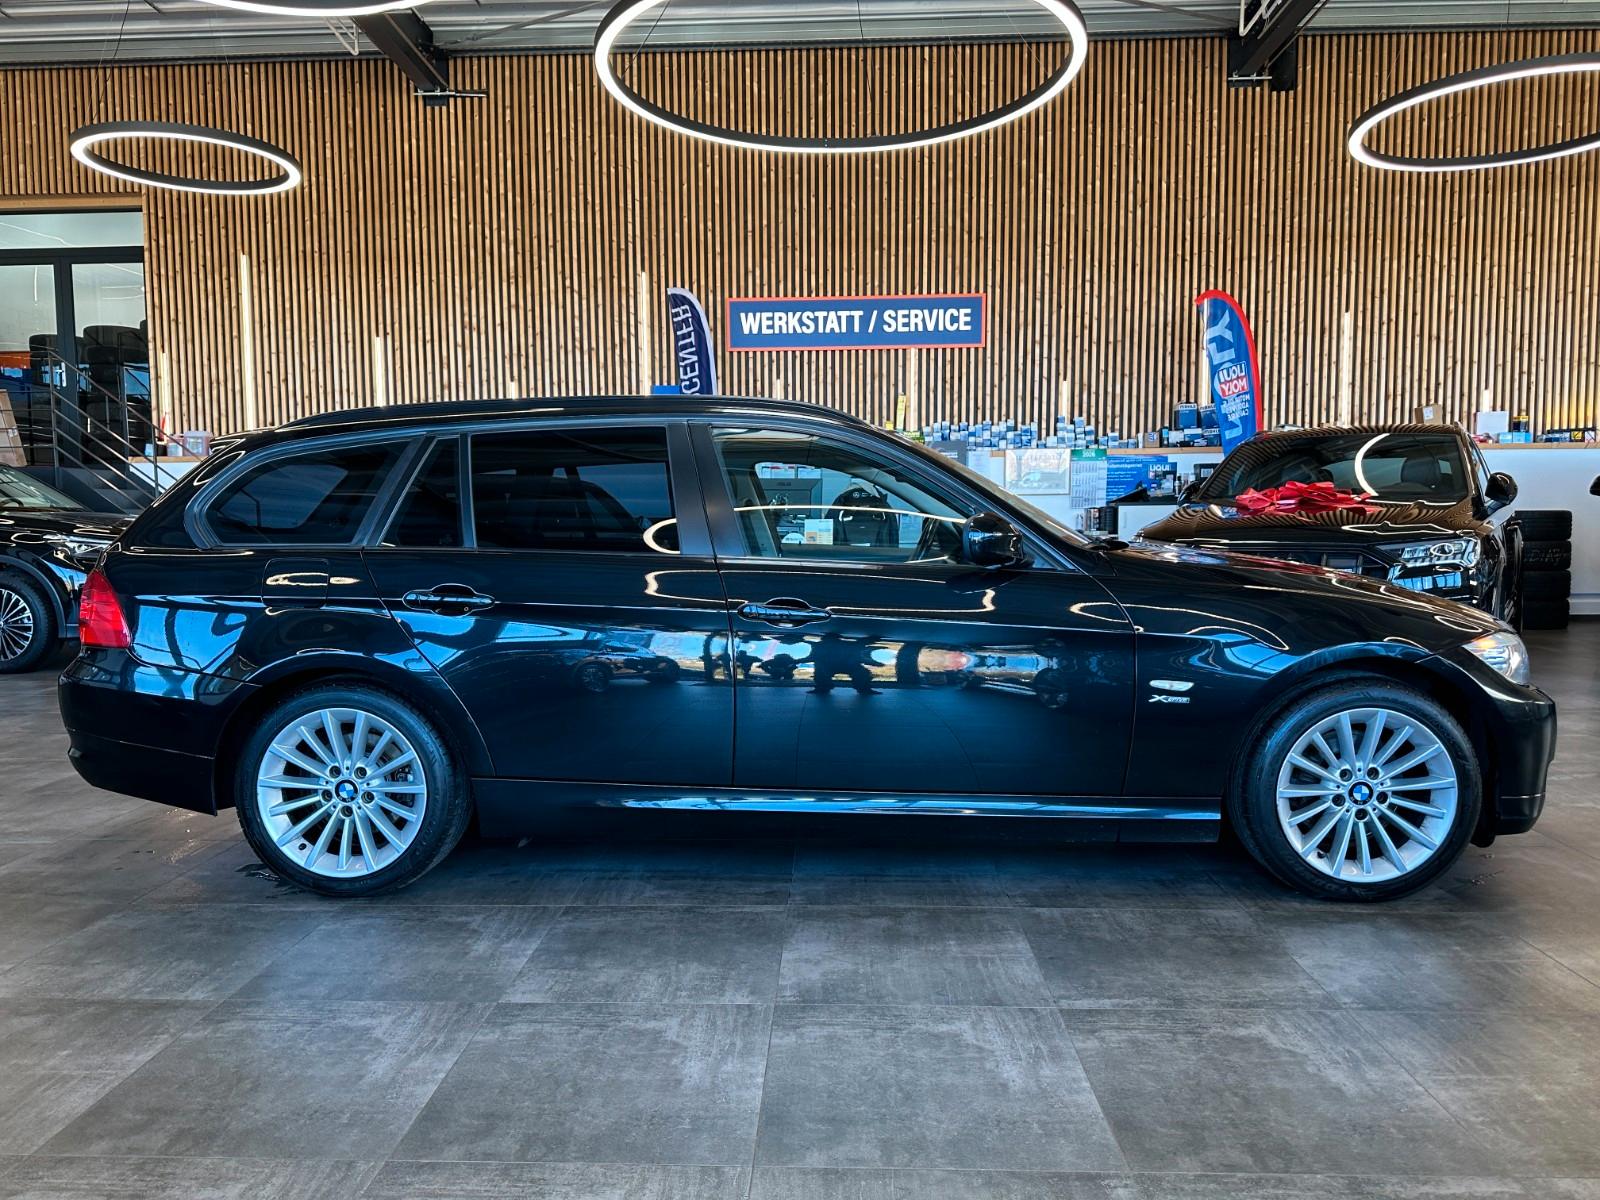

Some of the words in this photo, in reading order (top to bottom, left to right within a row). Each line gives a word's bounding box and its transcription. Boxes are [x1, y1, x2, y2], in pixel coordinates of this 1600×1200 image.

[740, 310, 863, 335] WERKSTATT
[868, 310, 878, 333] /
[883, 308, 971, 333] SERVICE
